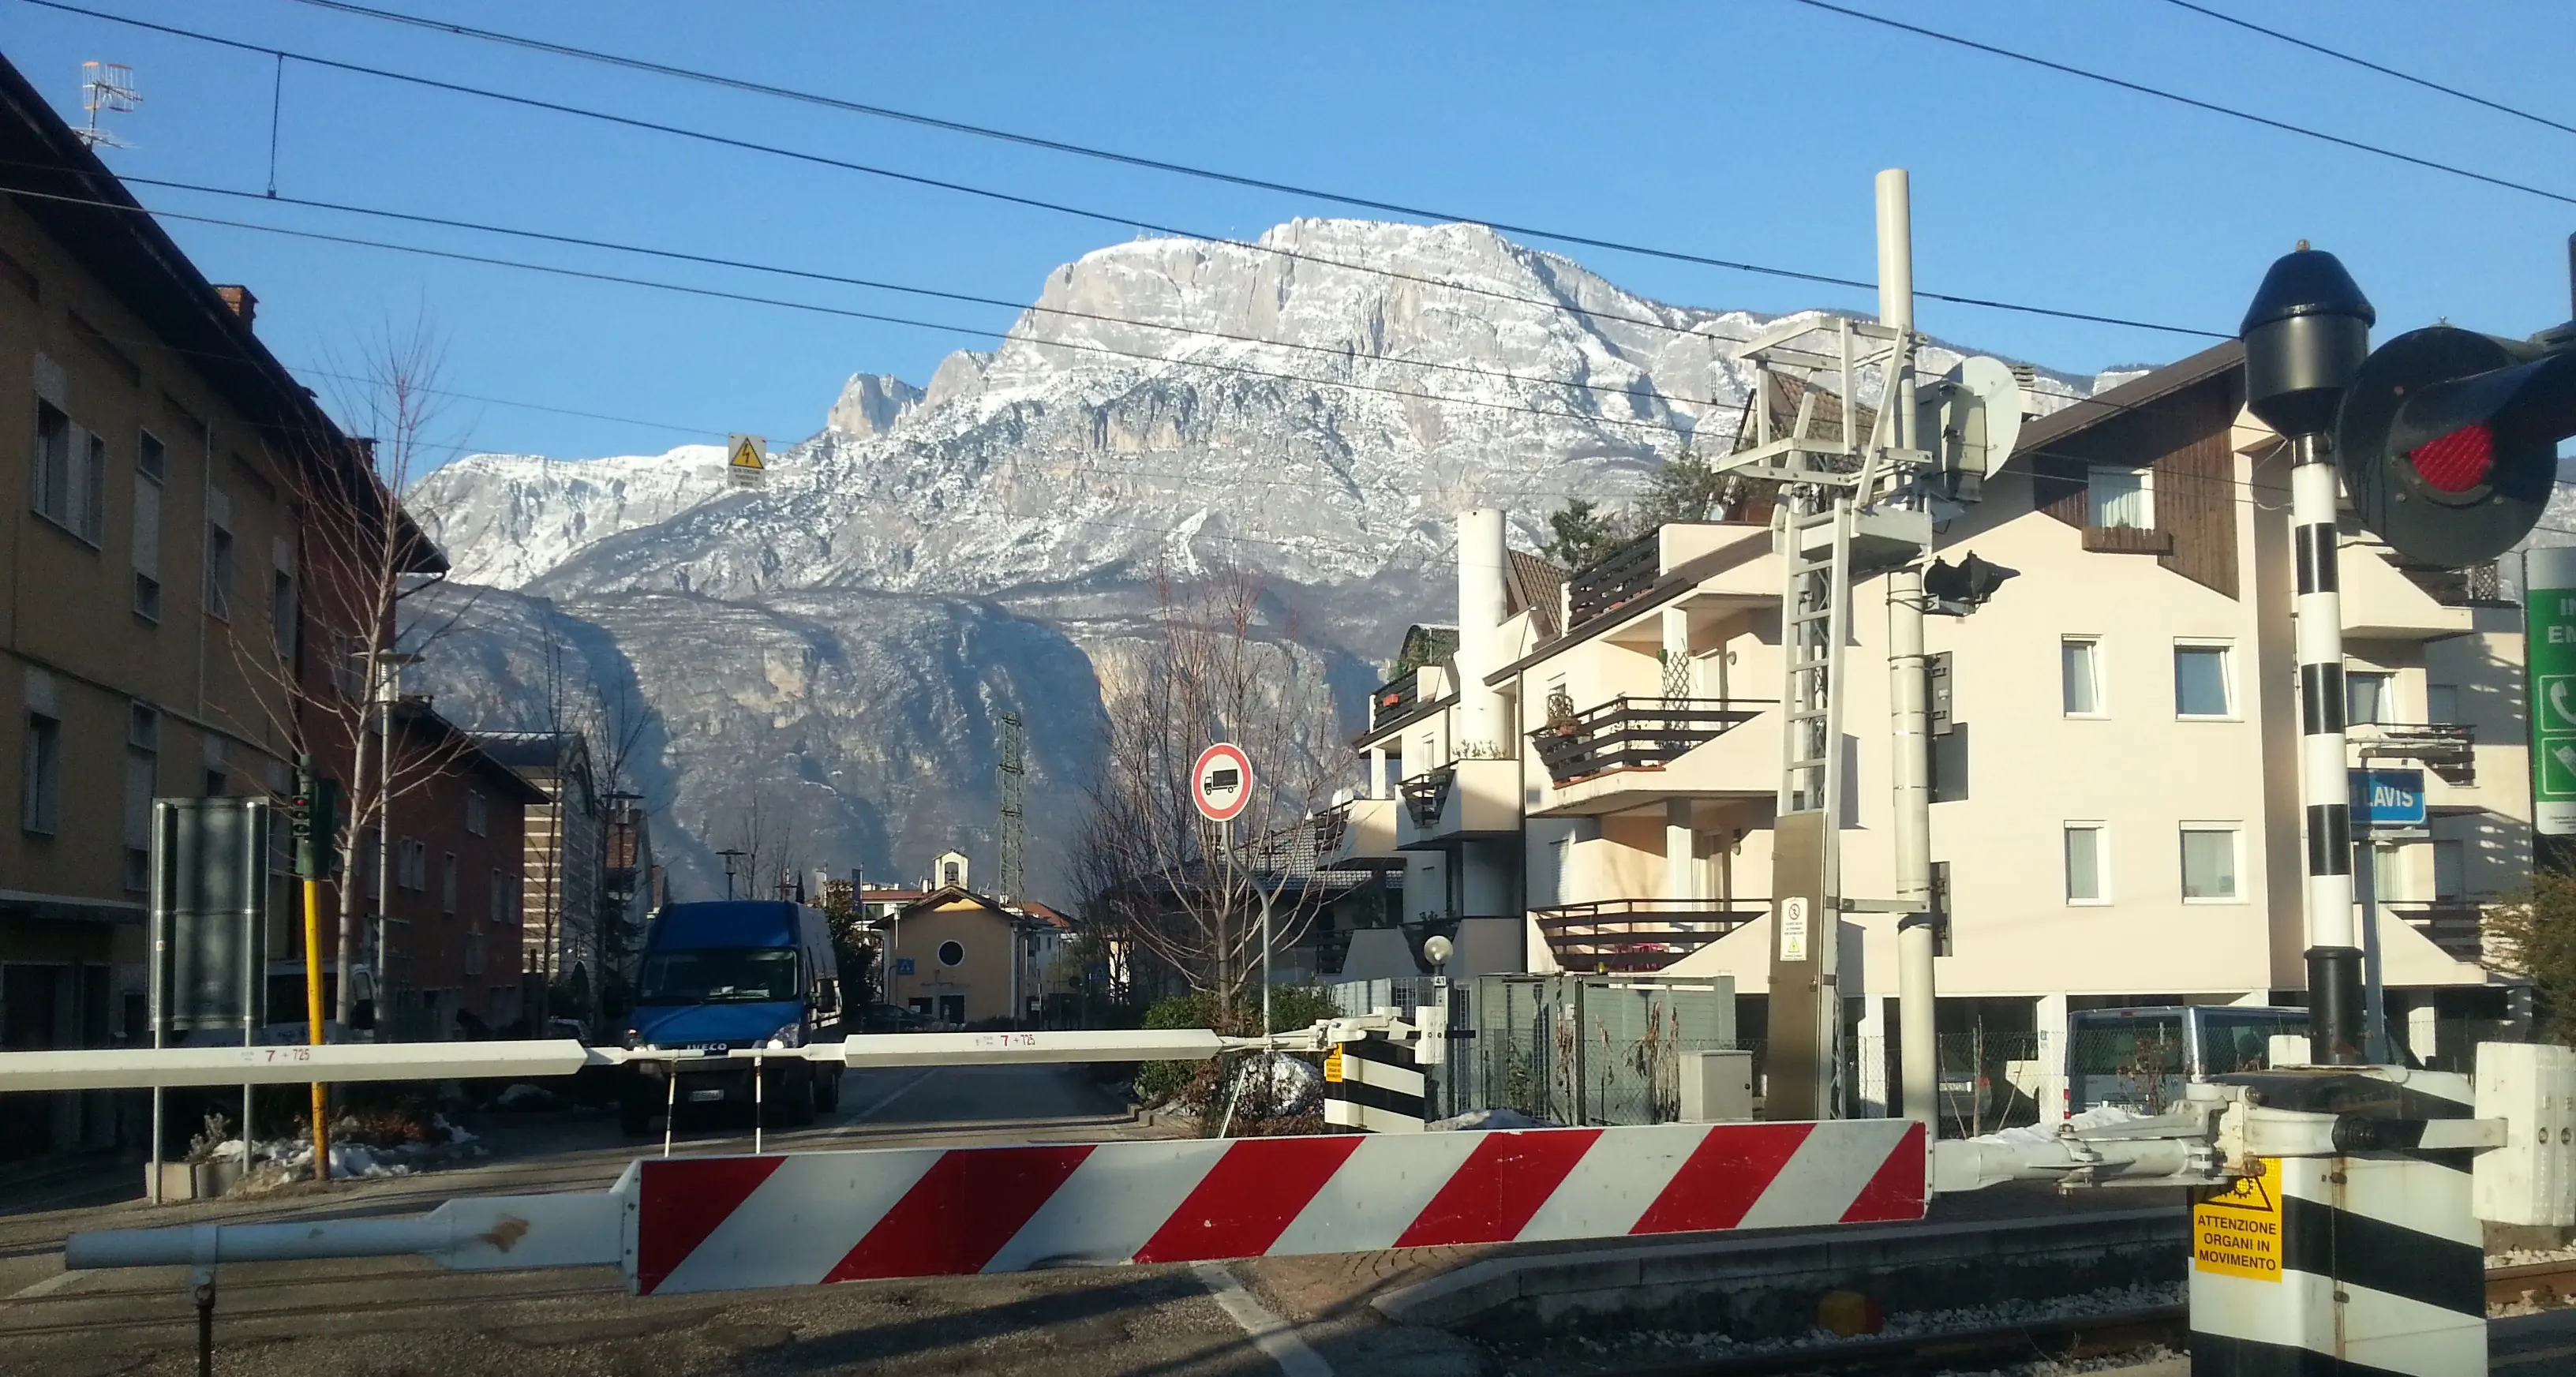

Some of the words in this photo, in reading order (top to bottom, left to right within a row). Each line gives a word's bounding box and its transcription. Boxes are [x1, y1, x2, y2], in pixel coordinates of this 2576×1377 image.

[2362, 784, 2414, 807] LAVIS
[687, 1042, 728, 1052] IVECO
[1000, 1035, 1009, 1046] 7
[265, 1050, 275, 1062] 7
[293, 1048, 310, 1061] 725
[2198, 1214, 2277, 1235] ATTENZIONE
[2203, 1233, 2253, 1250] ORGANI
[2257, 1240, 2271, 1252] IN
[2199, 1249, 2277, 1271] MOVIMENTO
